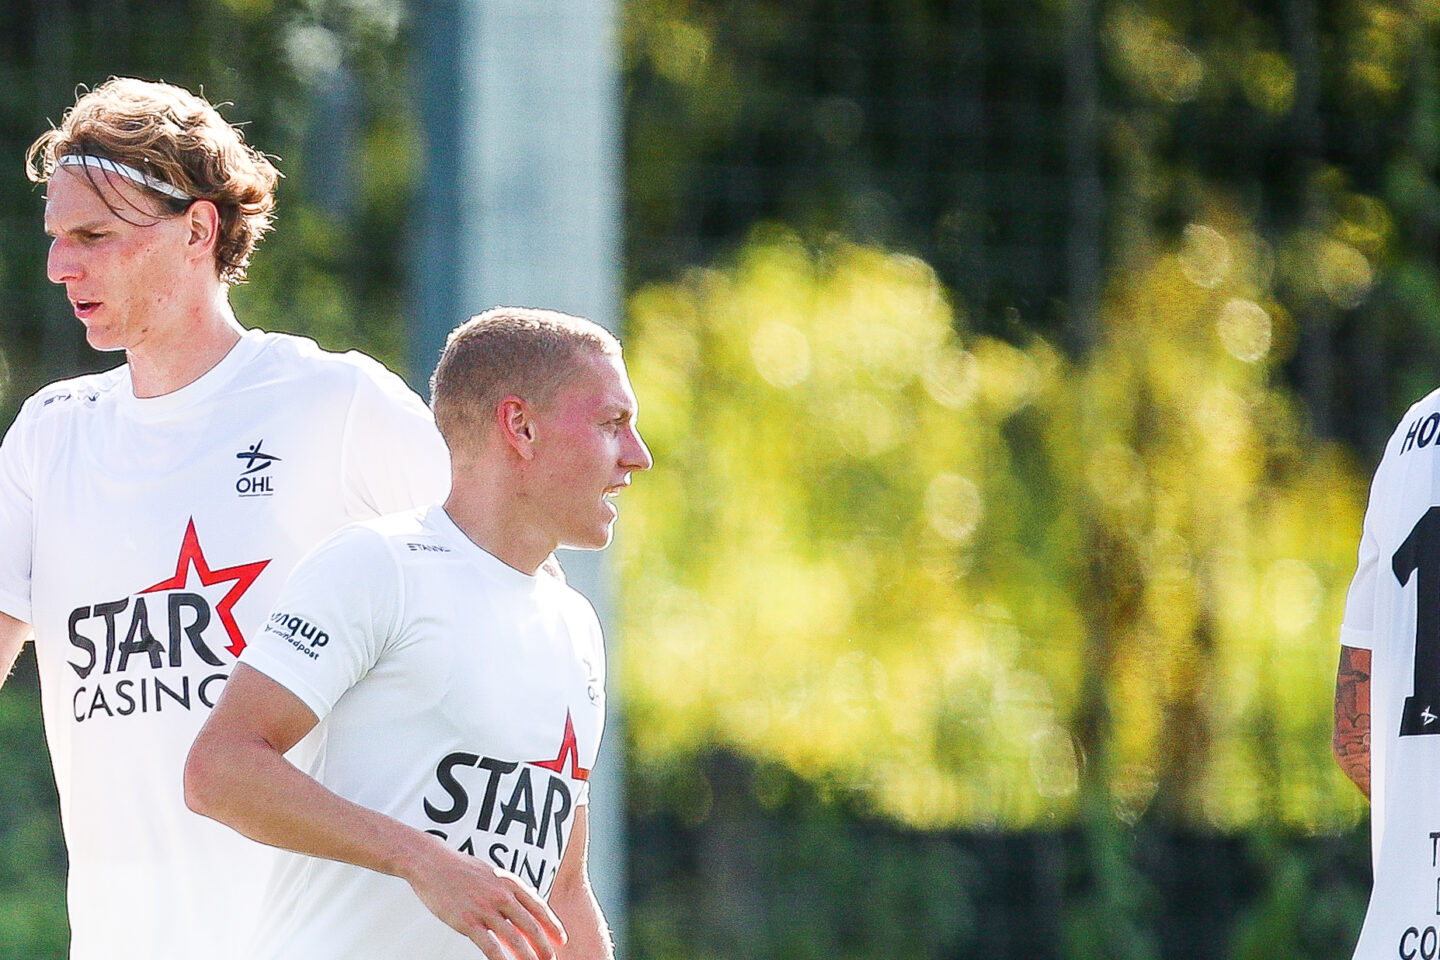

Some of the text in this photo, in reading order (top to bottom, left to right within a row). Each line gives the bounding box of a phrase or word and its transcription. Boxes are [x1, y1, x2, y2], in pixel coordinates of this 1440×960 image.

[1399, 411, 1440, 456] HO
[236, 476, 274, 493] OHL
[67, 592, 227, 679] STAR
[423, 751, 572, 861] STAR
